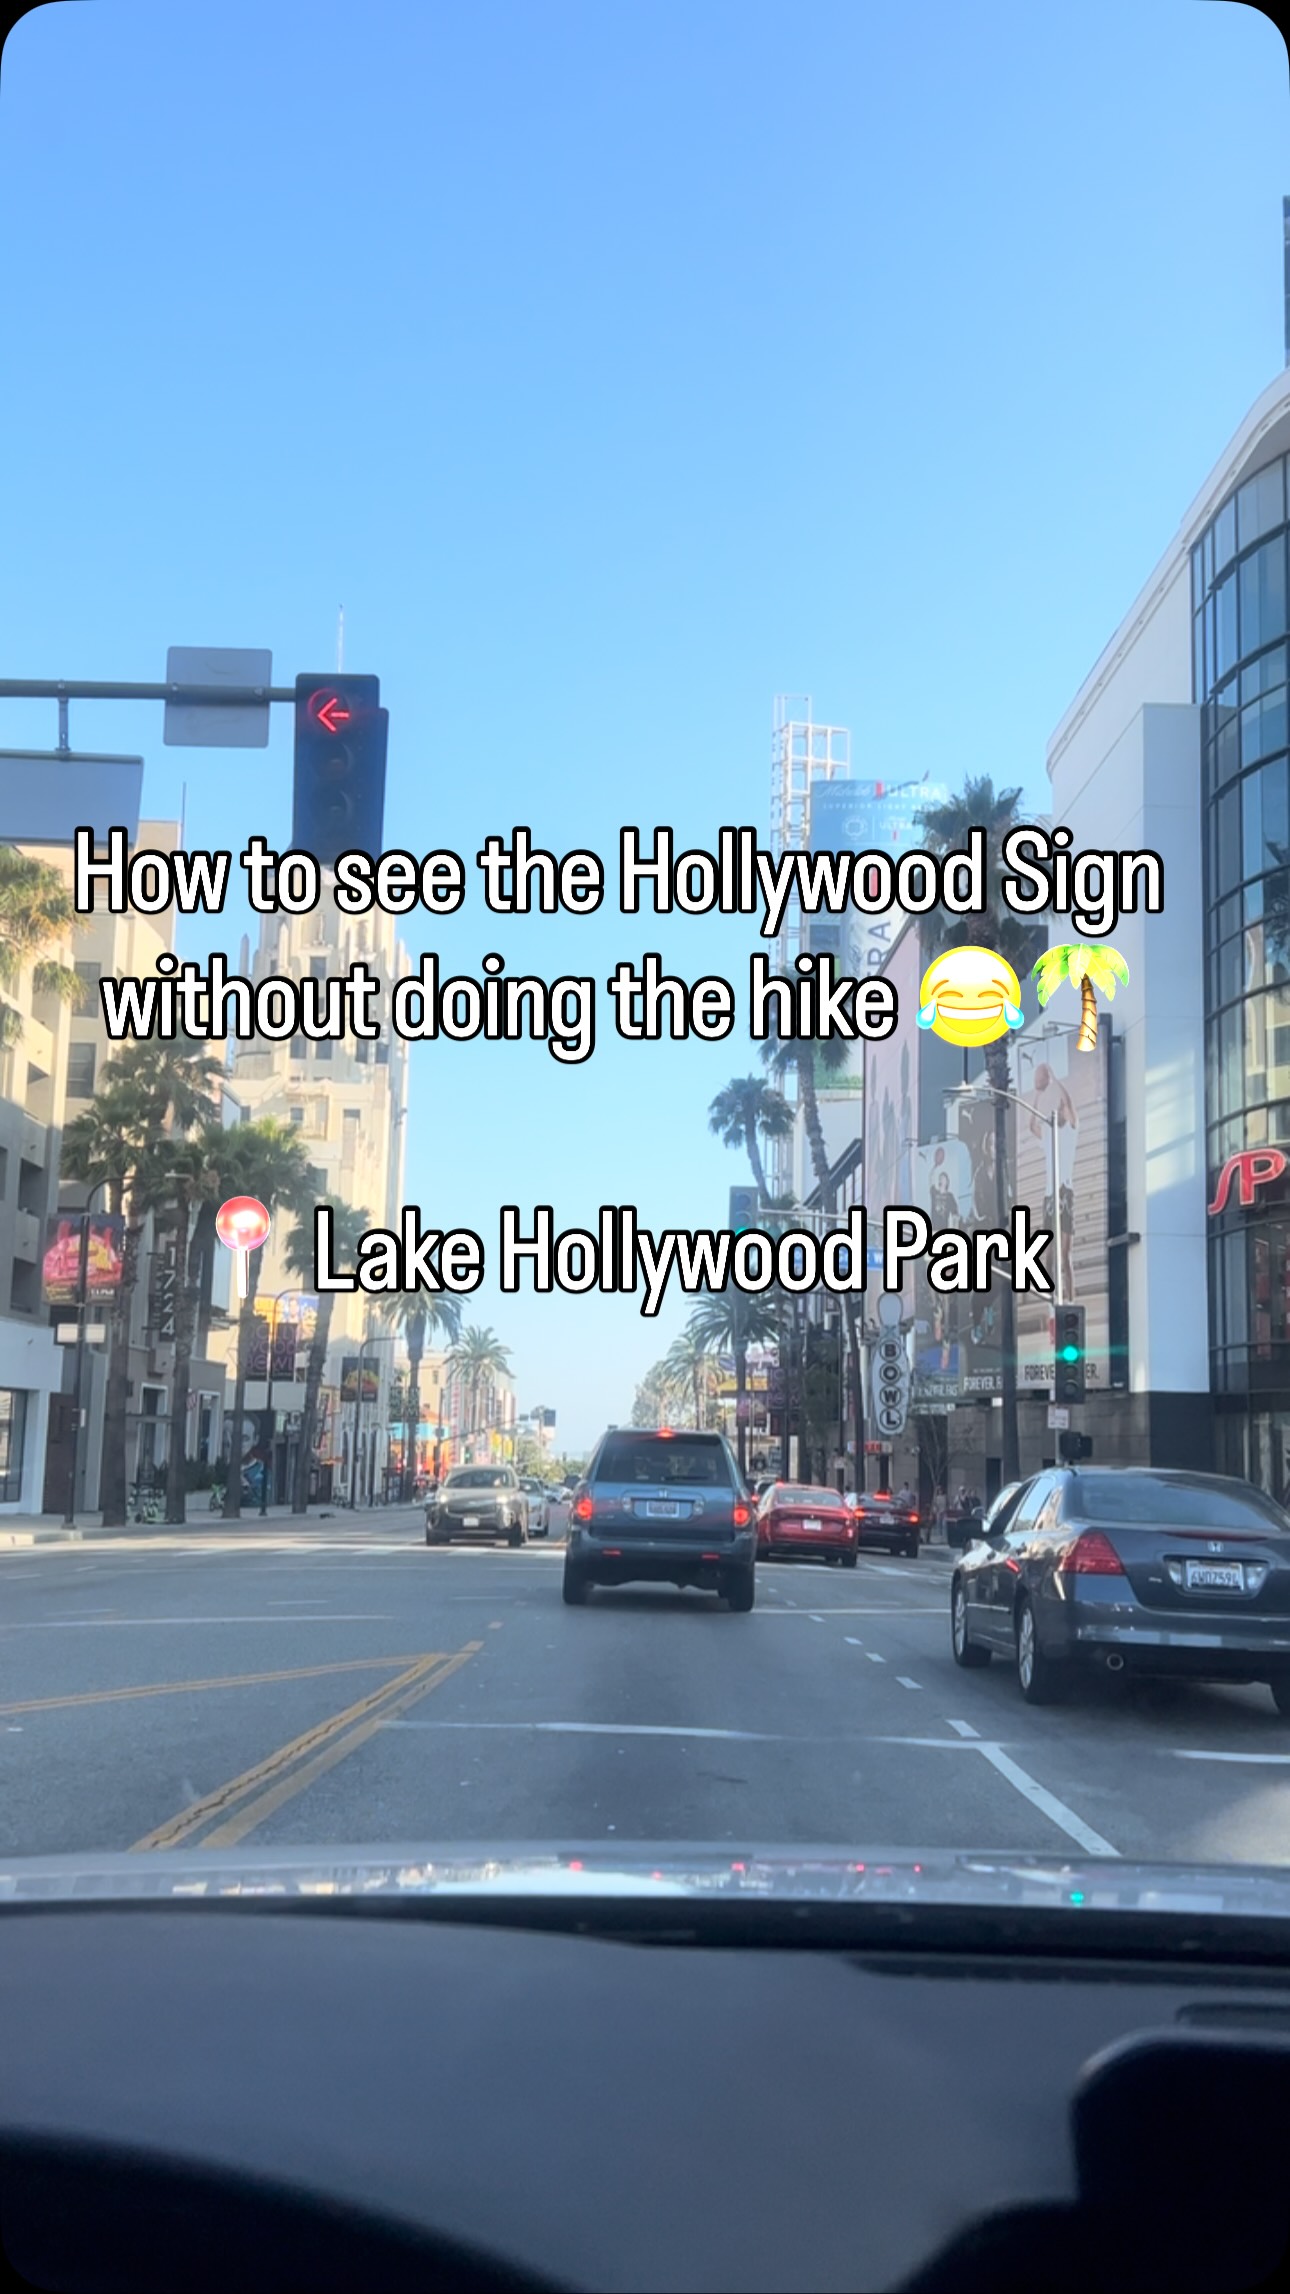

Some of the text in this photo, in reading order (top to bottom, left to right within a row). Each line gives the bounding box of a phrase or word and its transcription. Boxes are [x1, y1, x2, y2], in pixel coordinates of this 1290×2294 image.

[887, 783, 941, 799] ULTRA
[160, 1246, 177, 1336] 1724
[883, 1343, 899, 1426] BOWL
[1024, 1363, 1055, 1381] FOREVE
